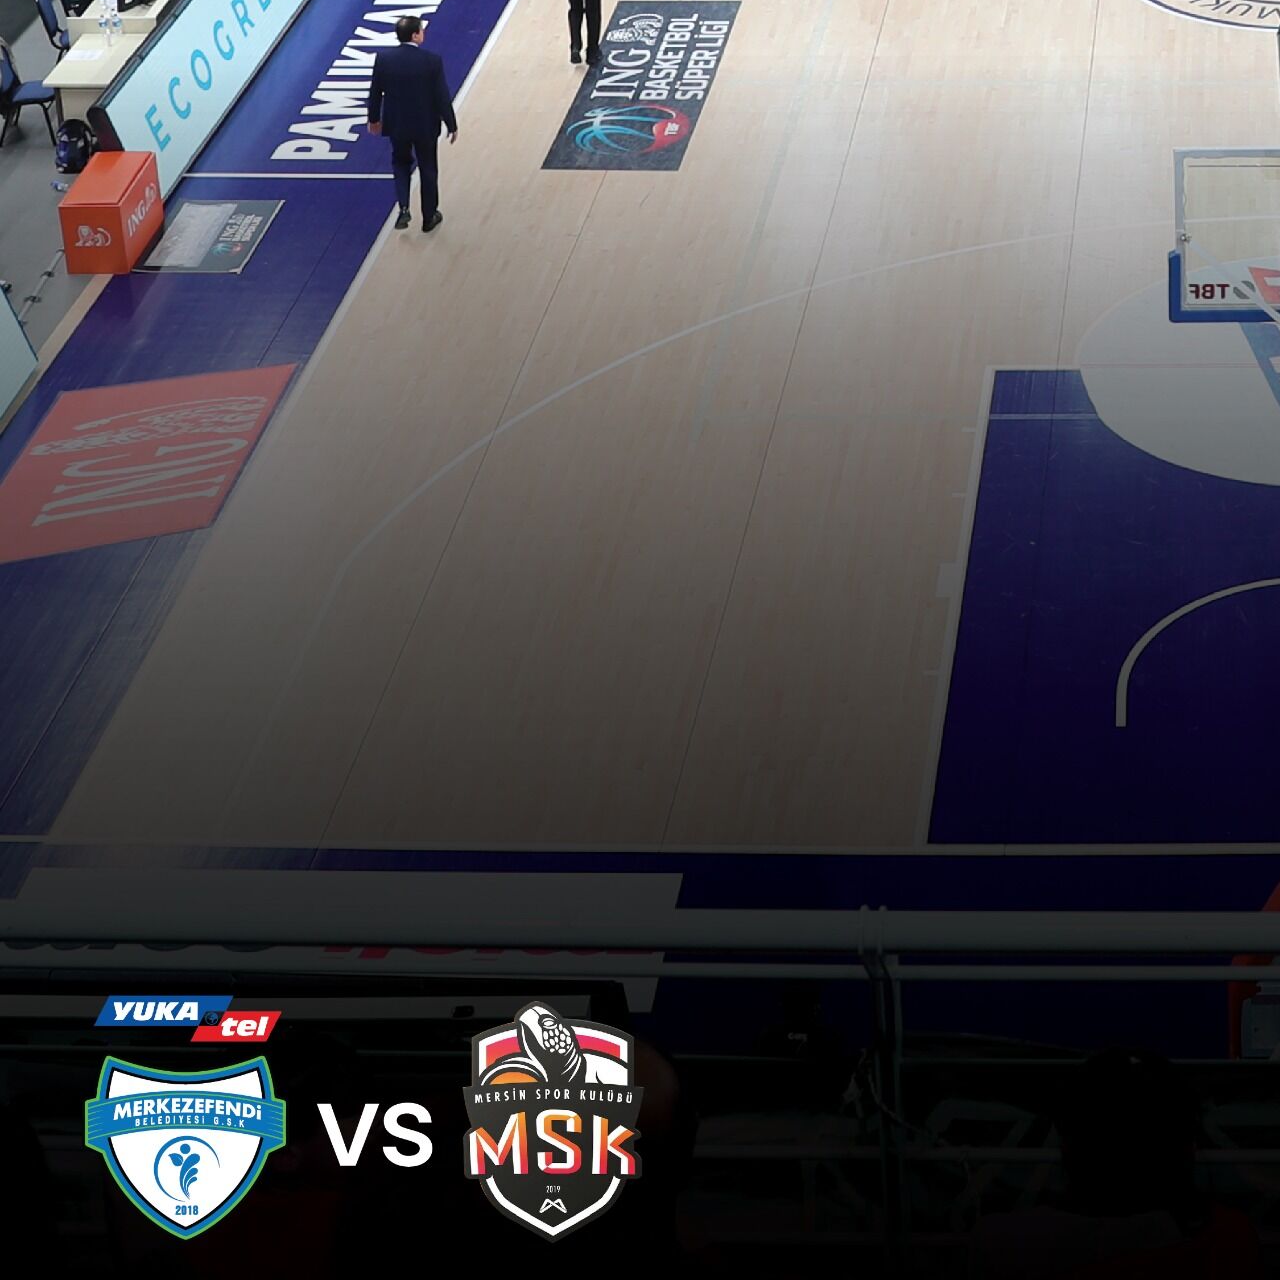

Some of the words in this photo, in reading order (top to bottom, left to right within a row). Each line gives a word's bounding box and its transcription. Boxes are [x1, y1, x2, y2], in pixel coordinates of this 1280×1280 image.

[639, 13, 699, 101] BASKETBOL
[694, 19, 730, 48] LİGİ
[591, 47, 651, 100] ING
[675, 49, 720, 100] SÜPER
[126, 205, 146, 238] ING
